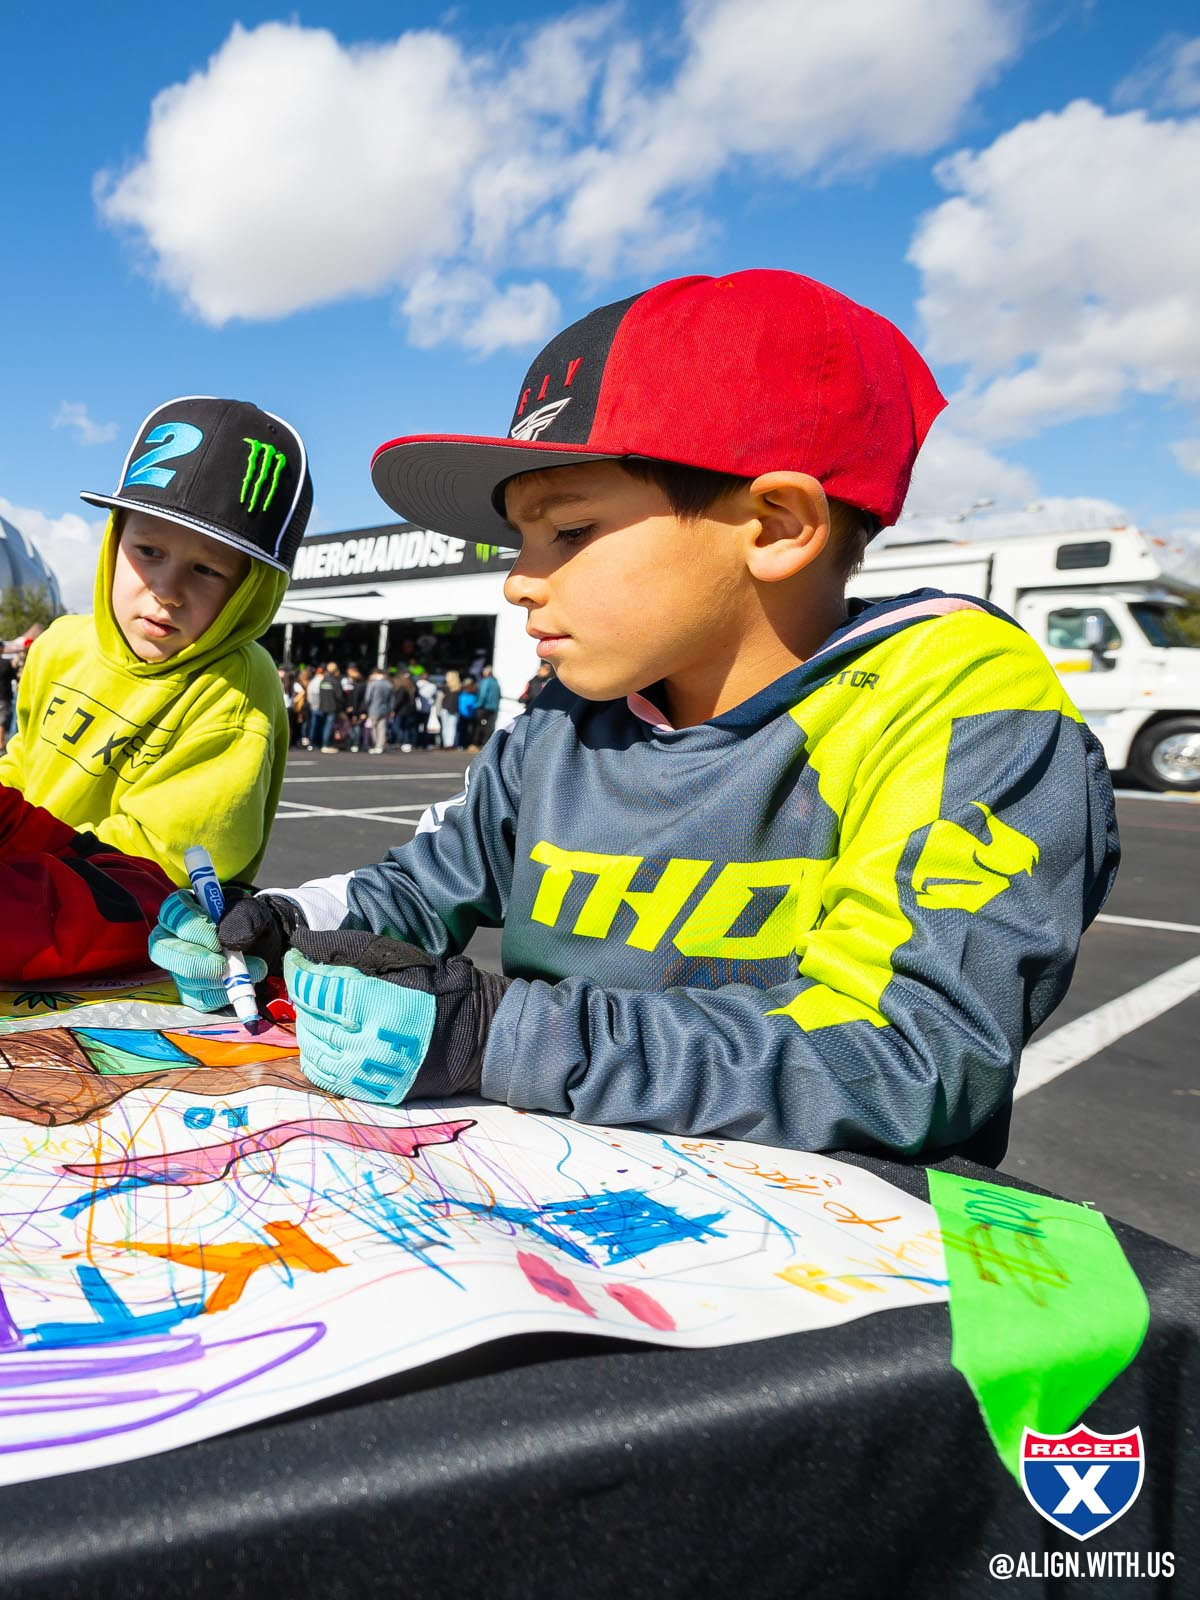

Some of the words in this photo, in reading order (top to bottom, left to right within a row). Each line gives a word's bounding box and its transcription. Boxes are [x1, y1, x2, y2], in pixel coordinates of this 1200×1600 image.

[124, 421, 204, 489] 2
[291, 530, 467, 580] MERCHANDISE
[824, 670, 880, 690] TOR
